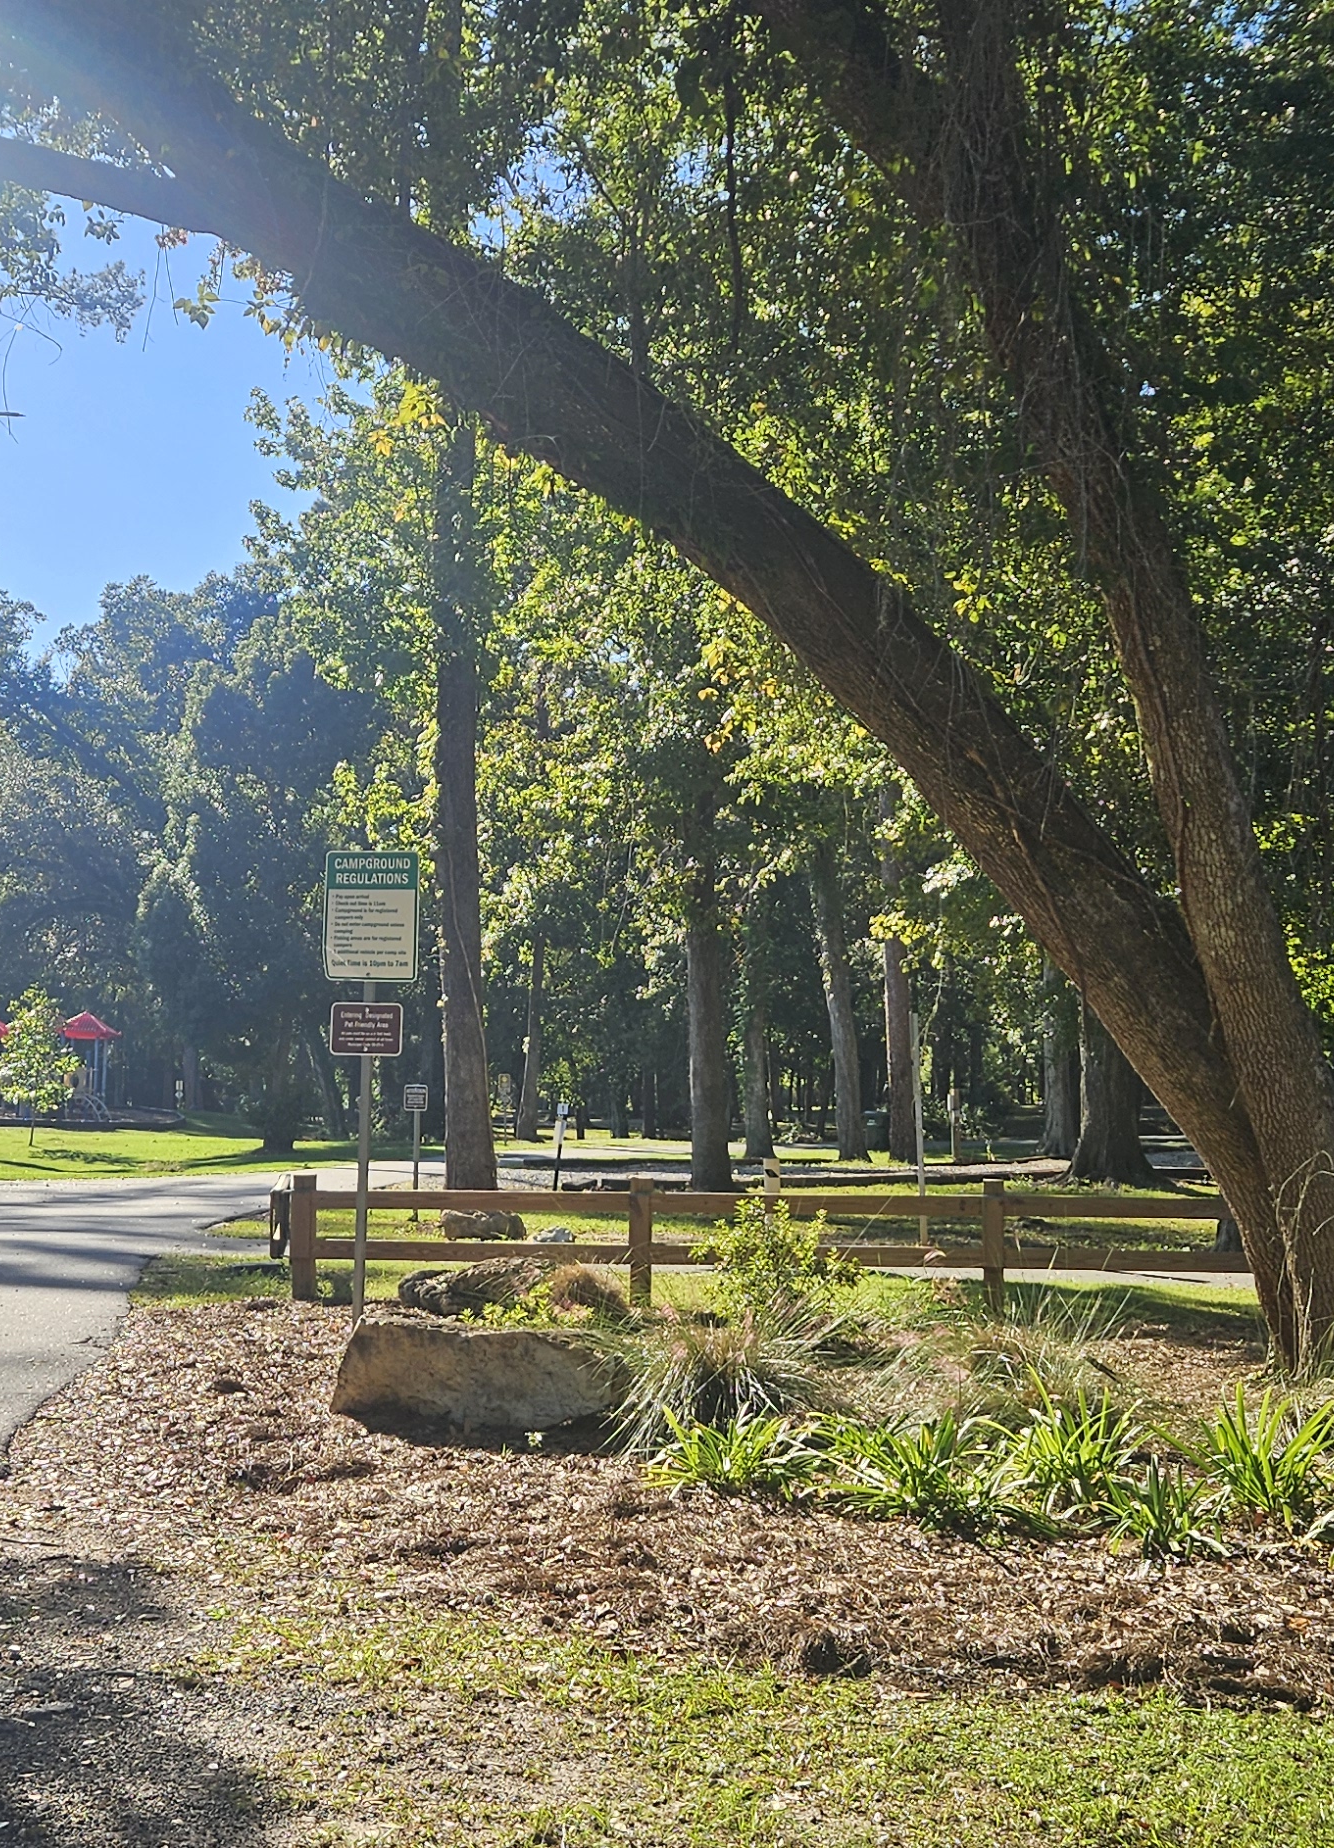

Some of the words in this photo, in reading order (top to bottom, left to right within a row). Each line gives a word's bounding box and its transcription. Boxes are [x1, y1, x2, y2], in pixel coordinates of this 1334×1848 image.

[335, 858, 411, 869] CAMPGROUND
[336, 873, 409, 884] REGULATIONS
[331, 959, 346, 967] Quiet
[340, 1011, 362, 1019] Entering
[365, 1012, 393, 1020] Designated
[355, 1021, 376, 1029] Friendly
